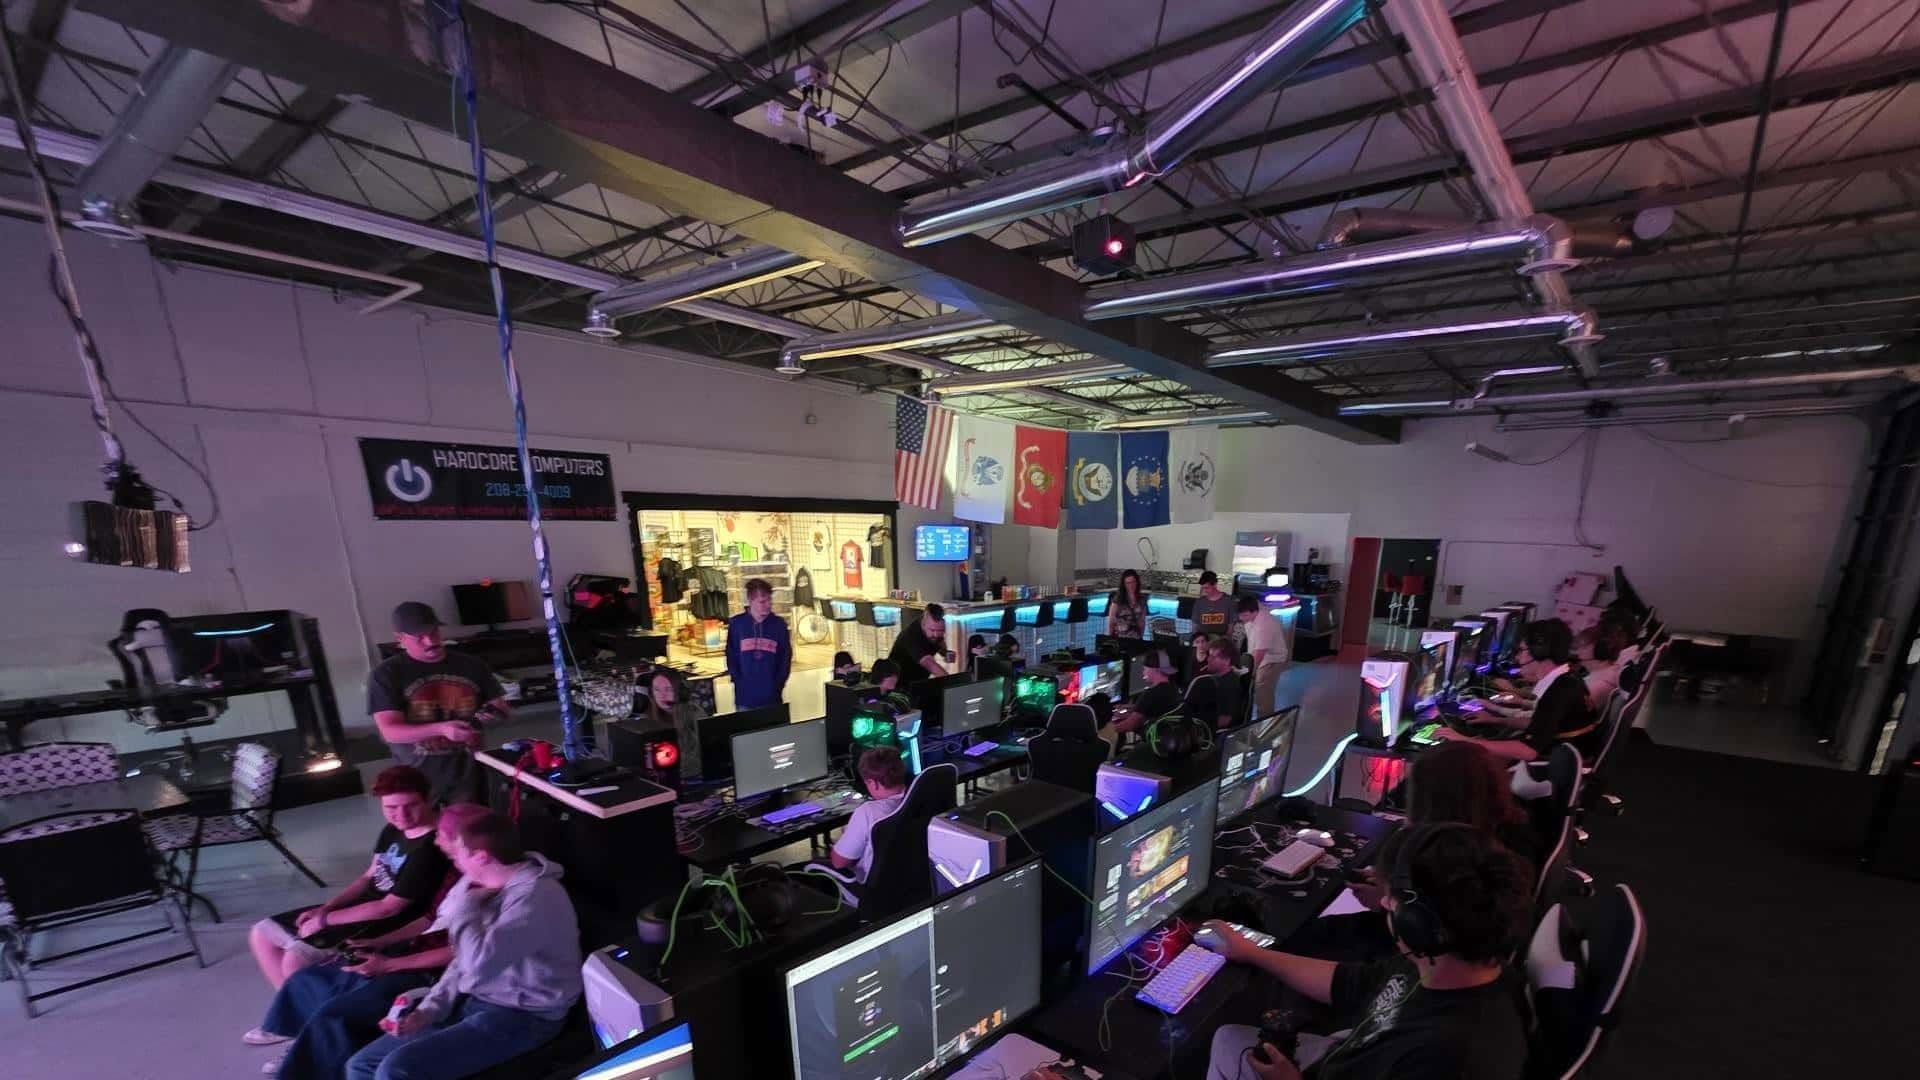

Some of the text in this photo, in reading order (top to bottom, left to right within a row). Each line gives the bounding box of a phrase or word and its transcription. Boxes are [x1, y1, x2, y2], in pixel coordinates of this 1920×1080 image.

[433, 449, 604, 476] HARDCORE OMPUTERS
[485, 482, 571, 498] 208-2-4009
